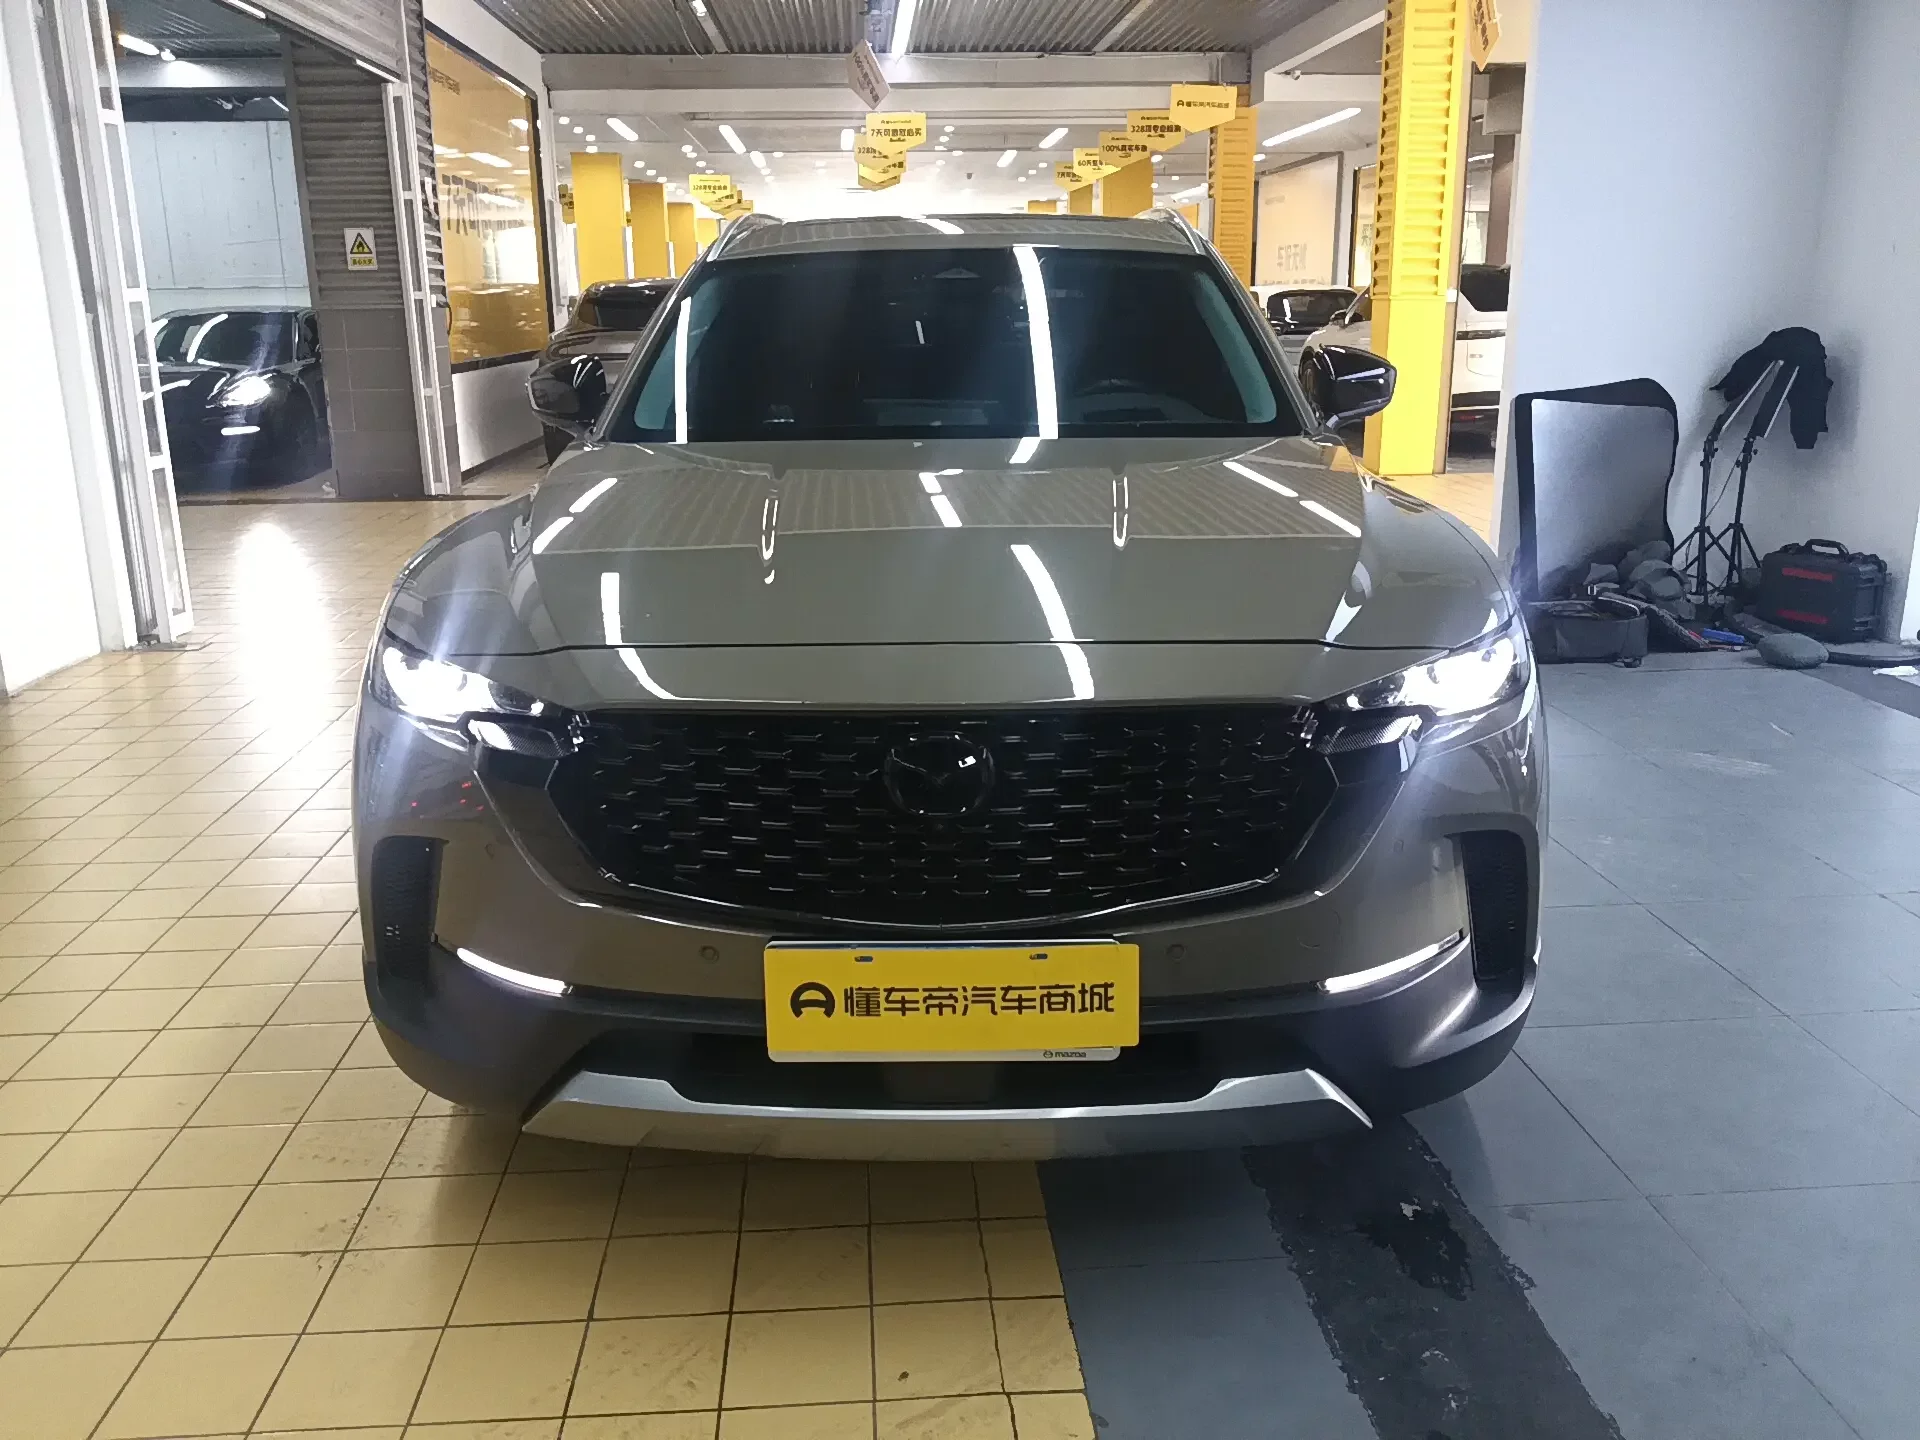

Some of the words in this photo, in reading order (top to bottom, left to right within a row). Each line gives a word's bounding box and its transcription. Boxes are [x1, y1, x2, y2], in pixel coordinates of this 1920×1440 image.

[843, 980, 1116, 1017] 懂车帝汽车商城
